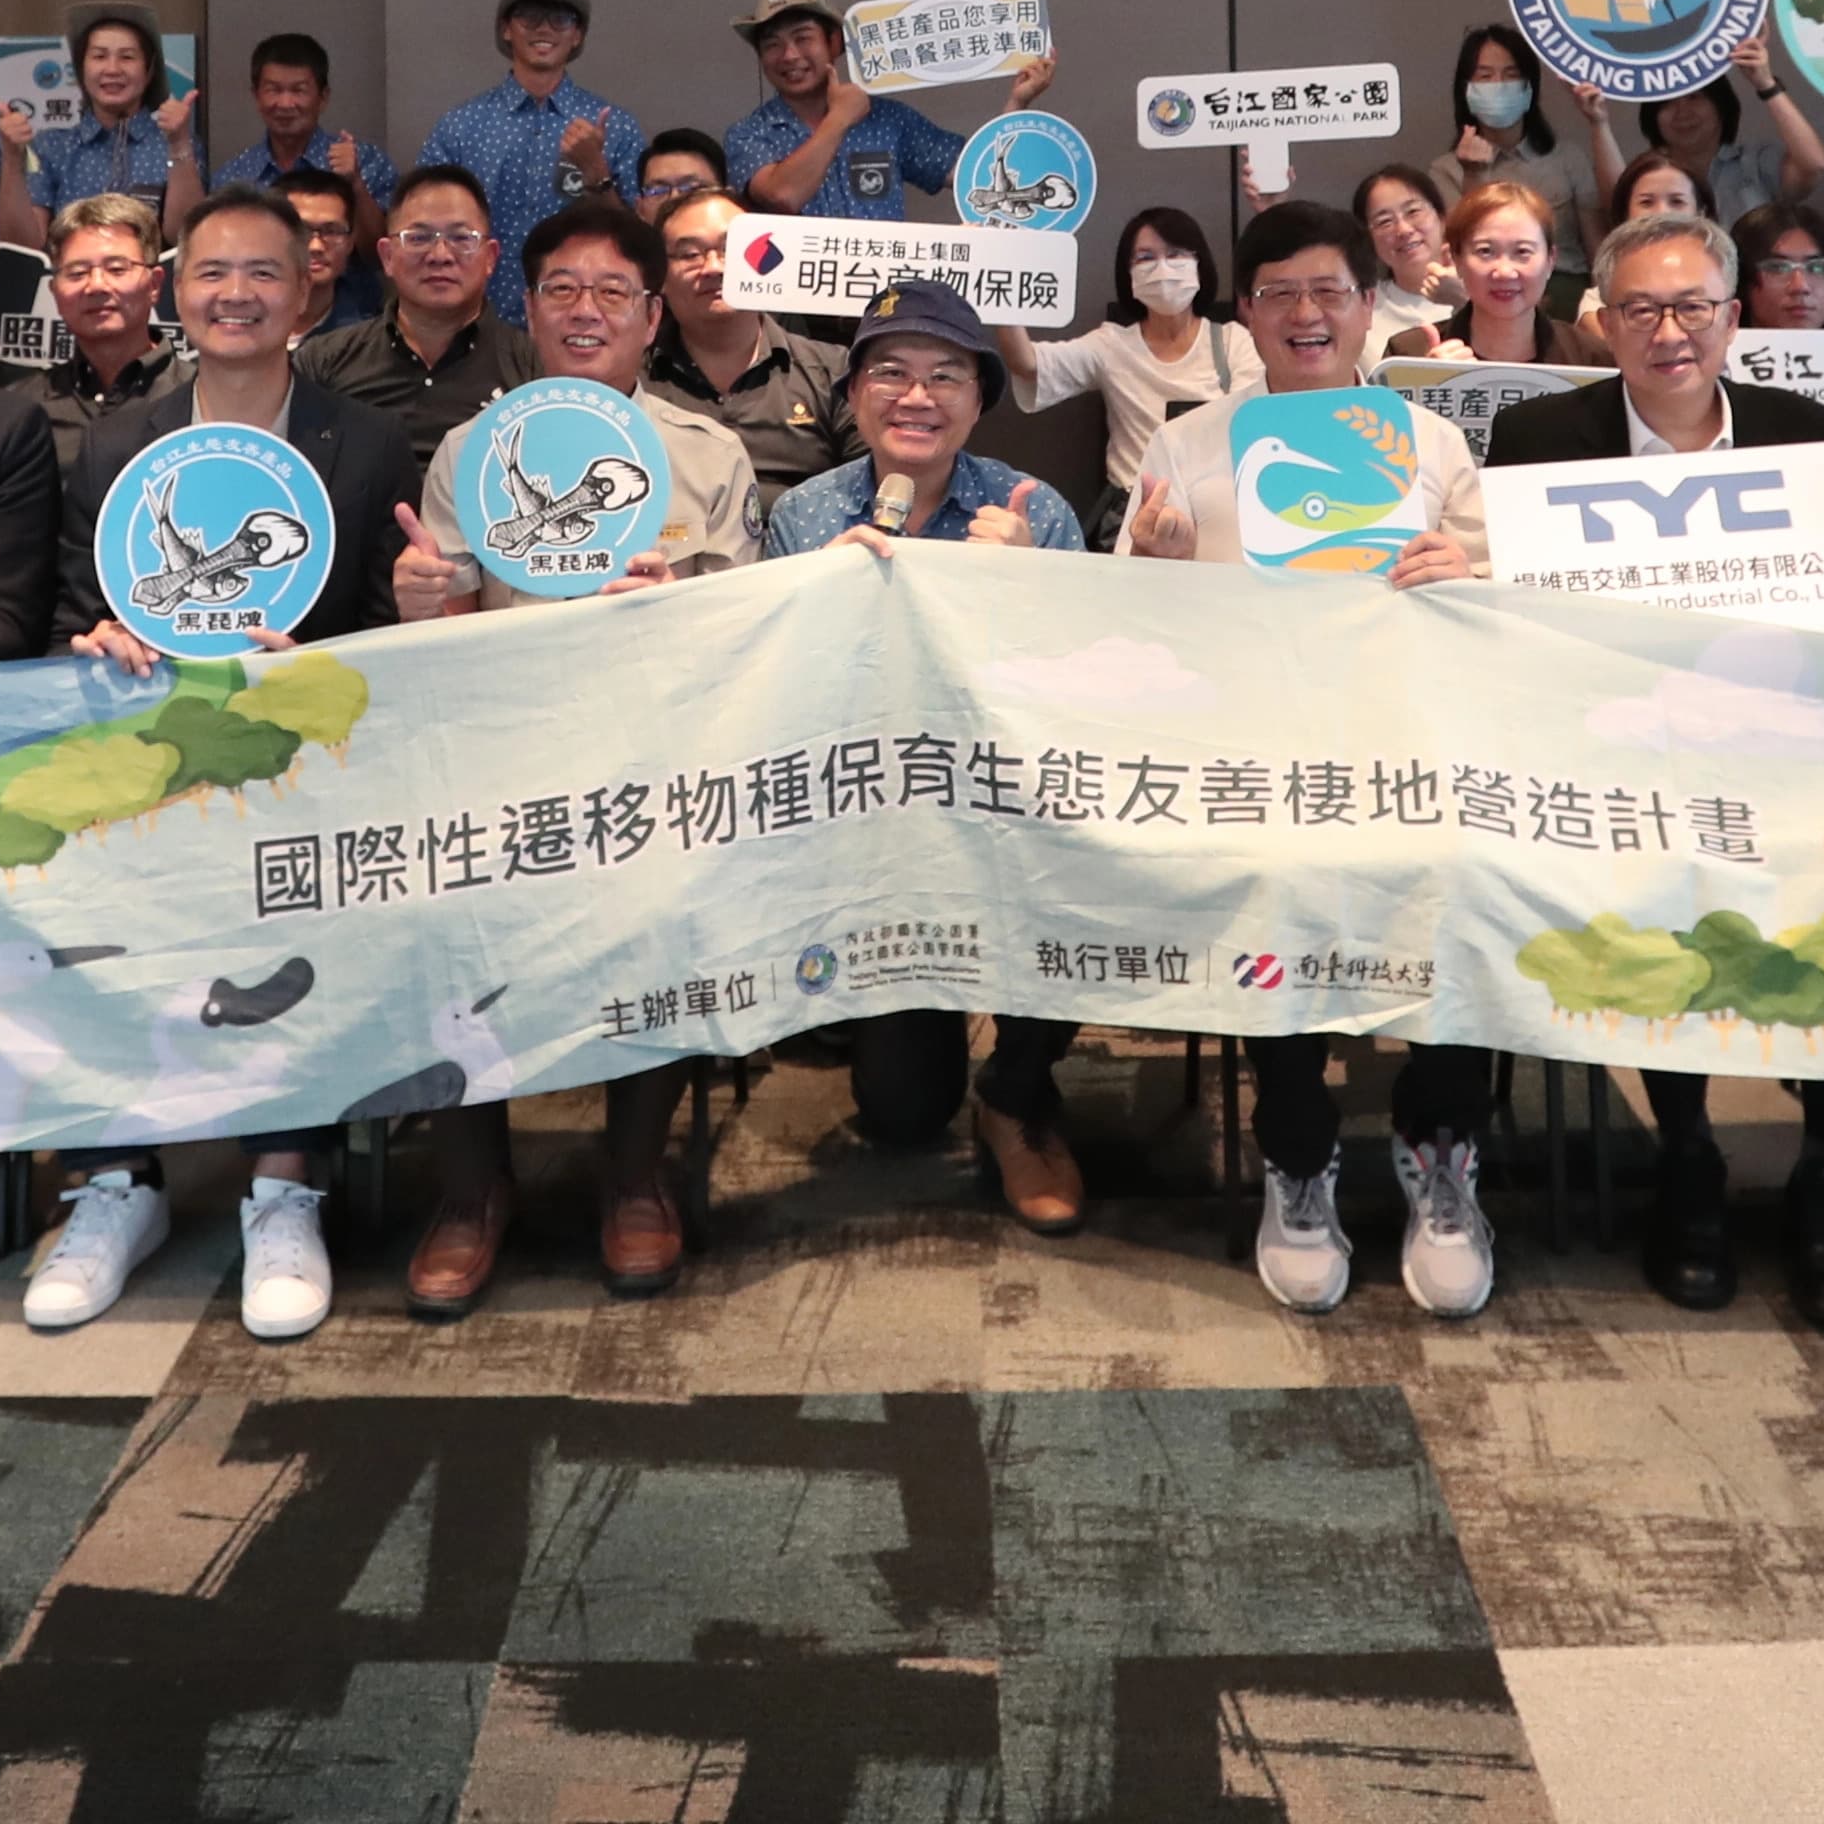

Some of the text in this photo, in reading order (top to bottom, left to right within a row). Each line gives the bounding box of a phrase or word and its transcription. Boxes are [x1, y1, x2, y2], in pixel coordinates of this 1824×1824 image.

[859, 1, 1039, 48] 黑琵產品您享用
[863, 30, 1044, 77] 水鳥餐桌我準備
[1204, 80, 1389, 116] 台江國家公園
[1209, 111, 1389, 132] TAIJIANG NATIONAL PARK
[800, 235, 971, 262] 三井住友海上集團
[739, 281, 783, 295] MSIG
[1546, 469, 1793, 543] TYC
[529, 554, 610, 574] 黑琵牌
[176, 612, 262, 632] 黑琵牌
[253, 731, 1765, 919] 國際性遷移物種保育生態友善棲地營造計畫
[1036, 940, 1190, 985] 執行單位
[601, 969, 757, 1040] 主辦單位
